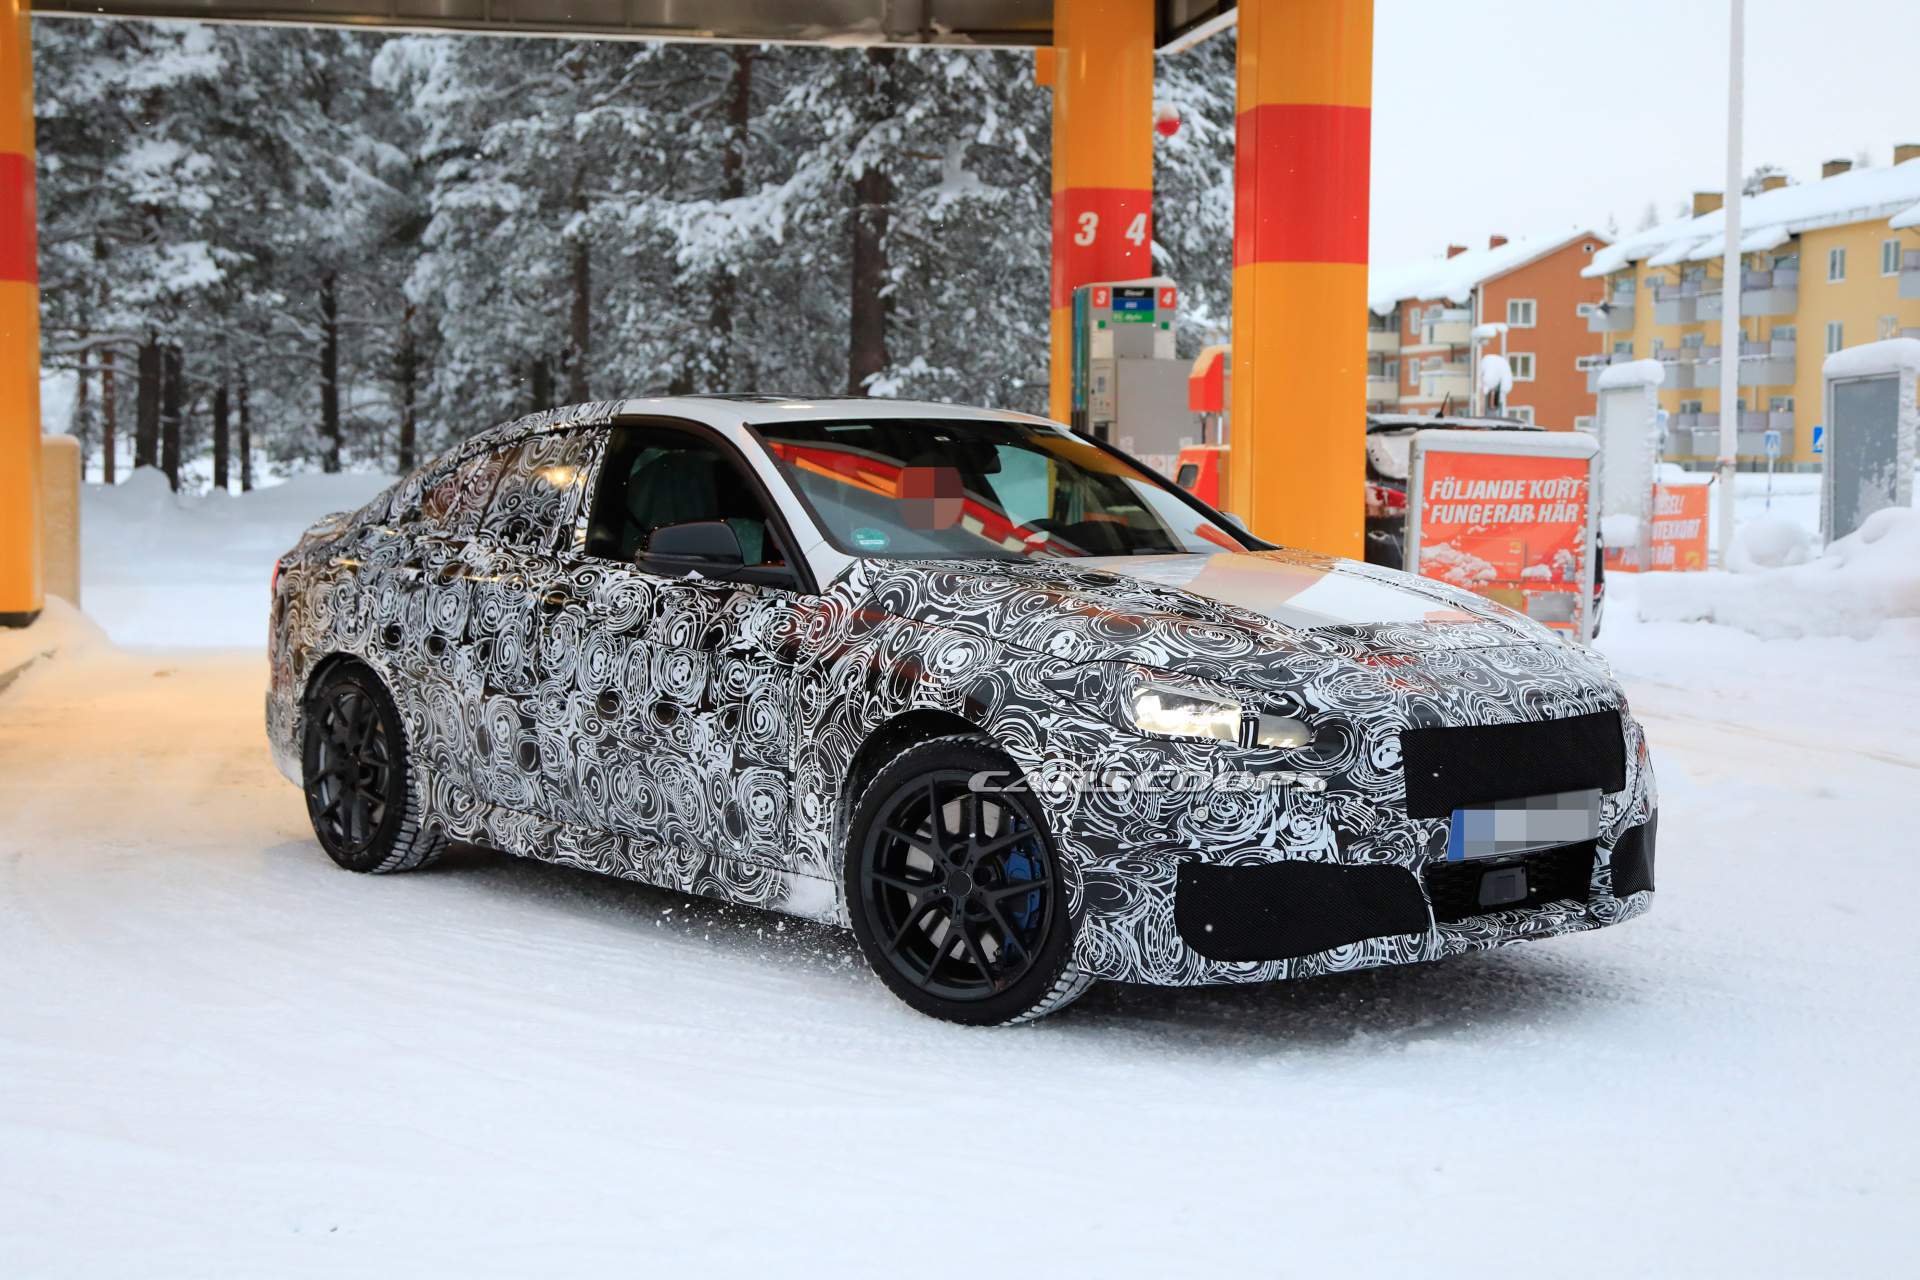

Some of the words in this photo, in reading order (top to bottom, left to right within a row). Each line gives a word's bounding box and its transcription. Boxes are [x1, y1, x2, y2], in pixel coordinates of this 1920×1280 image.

[1074, 211, 1099, 246] 3
[1124, 212, 1148, 246] 4
[1096, 290, 1107, 305] 3
[1162, 290, 1173, 305] 4
[1429, 476, 1527, 500] FÖLJANDE
[1529, 479, 1582, 499] KORT
[1430, 503, 1535, 524] FUNGERAR
[1537, 499, 1580, 523] HÄR
